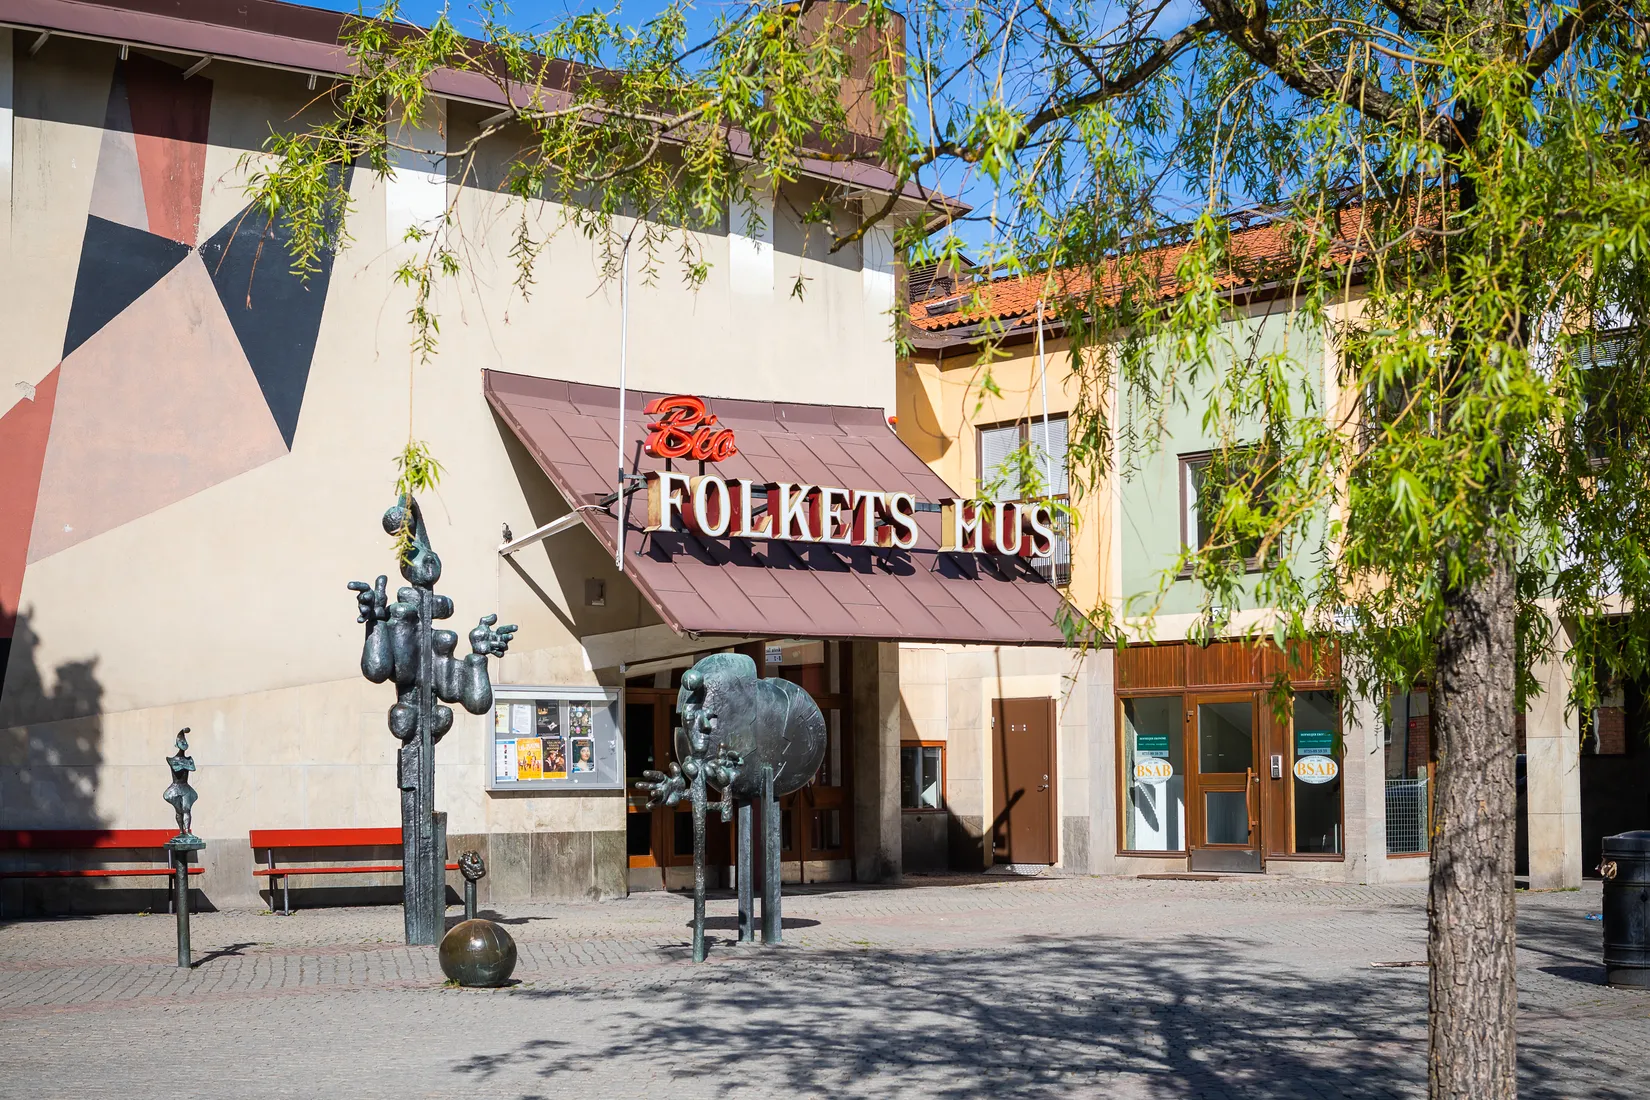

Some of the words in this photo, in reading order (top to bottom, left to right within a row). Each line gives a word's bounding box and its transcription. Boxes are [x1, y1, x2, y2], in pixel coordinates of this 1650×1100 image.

[643, 394, 737, 462] Bio
[645, 471, 919, 550] FOLKETS
[1137, 764, 1171, 777] BSAB
[1297, 762, 1336, 776] BSAB
